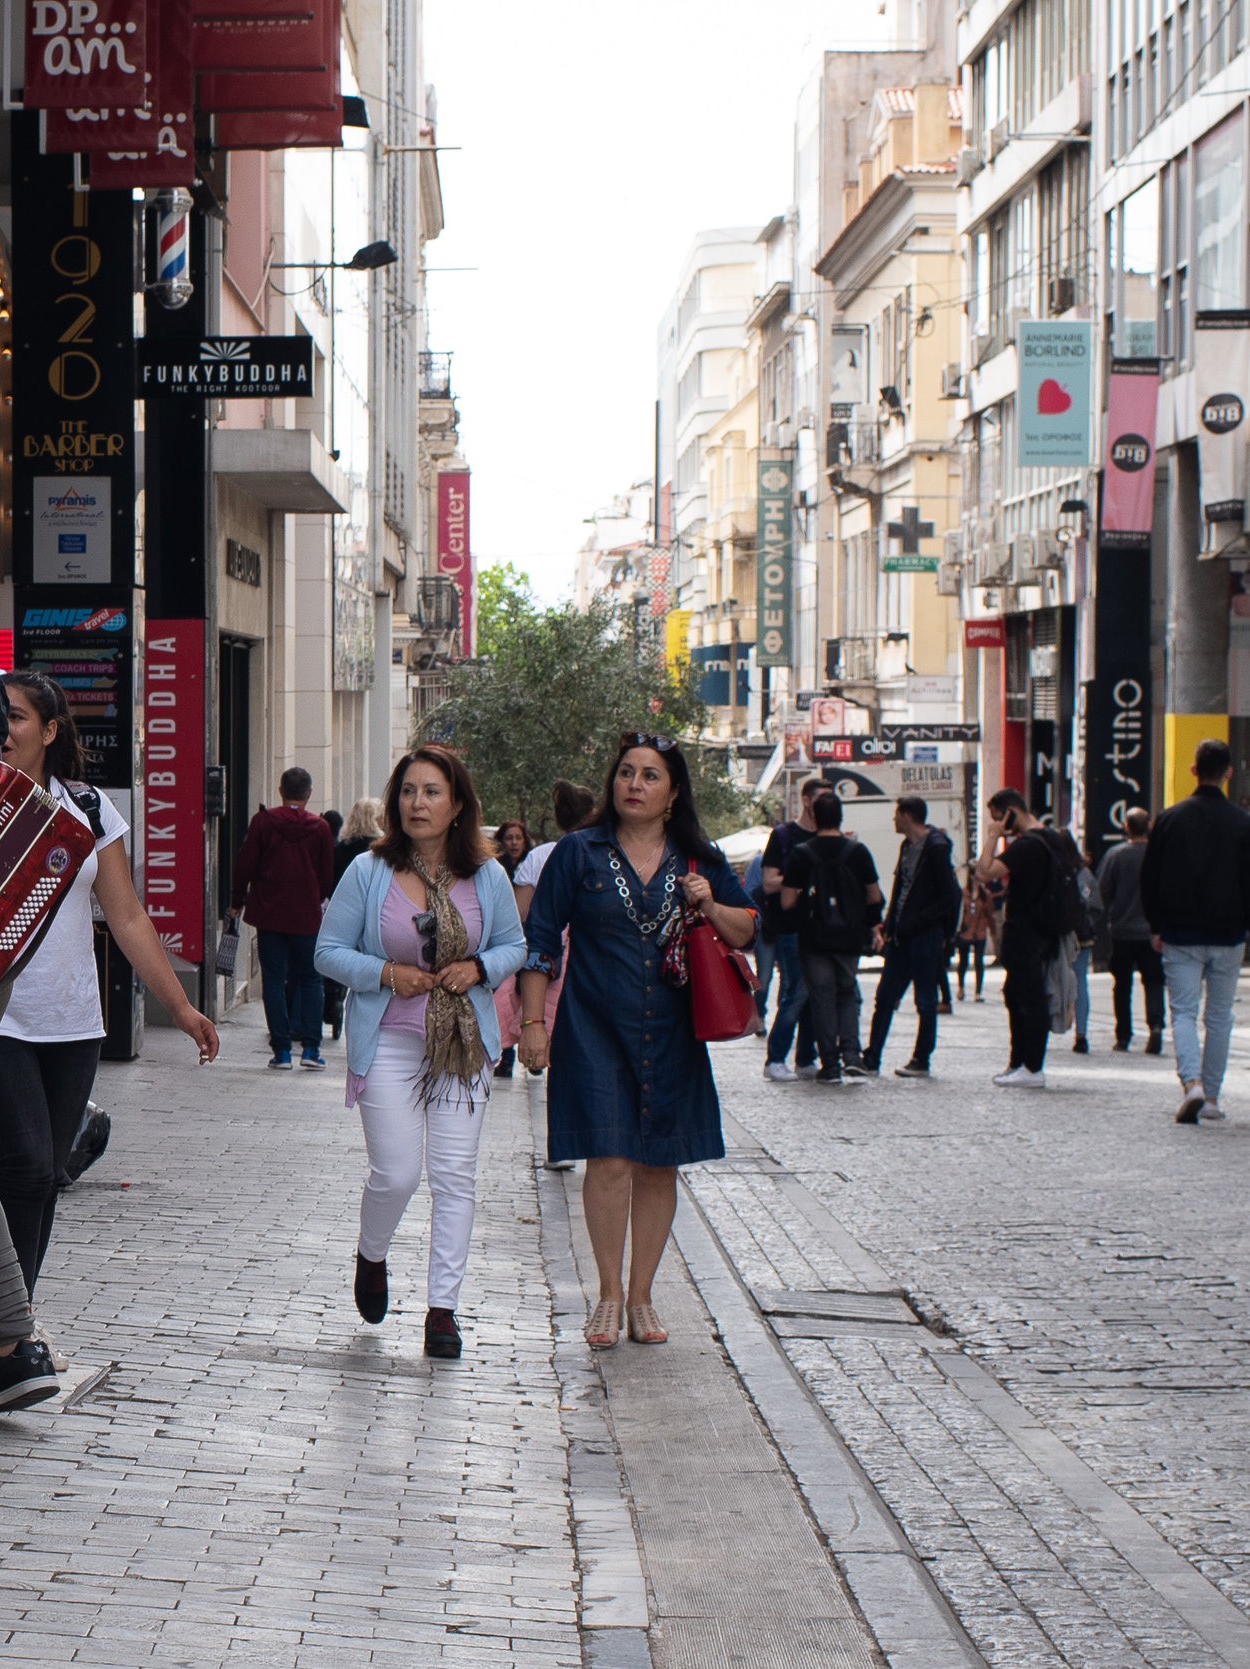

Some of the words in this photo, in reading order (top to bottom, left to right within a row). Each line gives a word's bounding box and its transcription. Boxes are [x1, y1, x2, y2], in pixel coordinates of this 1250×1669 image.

[44, 36, 137, 76] am
[144, 364, 307, 383] FUNKYBUDDHA
[171, 384, 188, 393] THE
[60, 420, 88, 434] THE
[23, 433, 125, 457] BARBER
[54, 458, 95, 473] SHOP
[48, 494, 97, 508] pyramis
[440, 486, 465, 575] Center
[22, 608, 93, 627] GINIS
[83, 608, 110, 631] travel
[54, 663, 86, 673] COACH
[88, 663, 114, 673] TRIPS
[77, 692, 115, 701] TICKETS
[883, 725, 980, 740] VANITY
[148, 636, 177, 918] FUNKYBUDDHA
